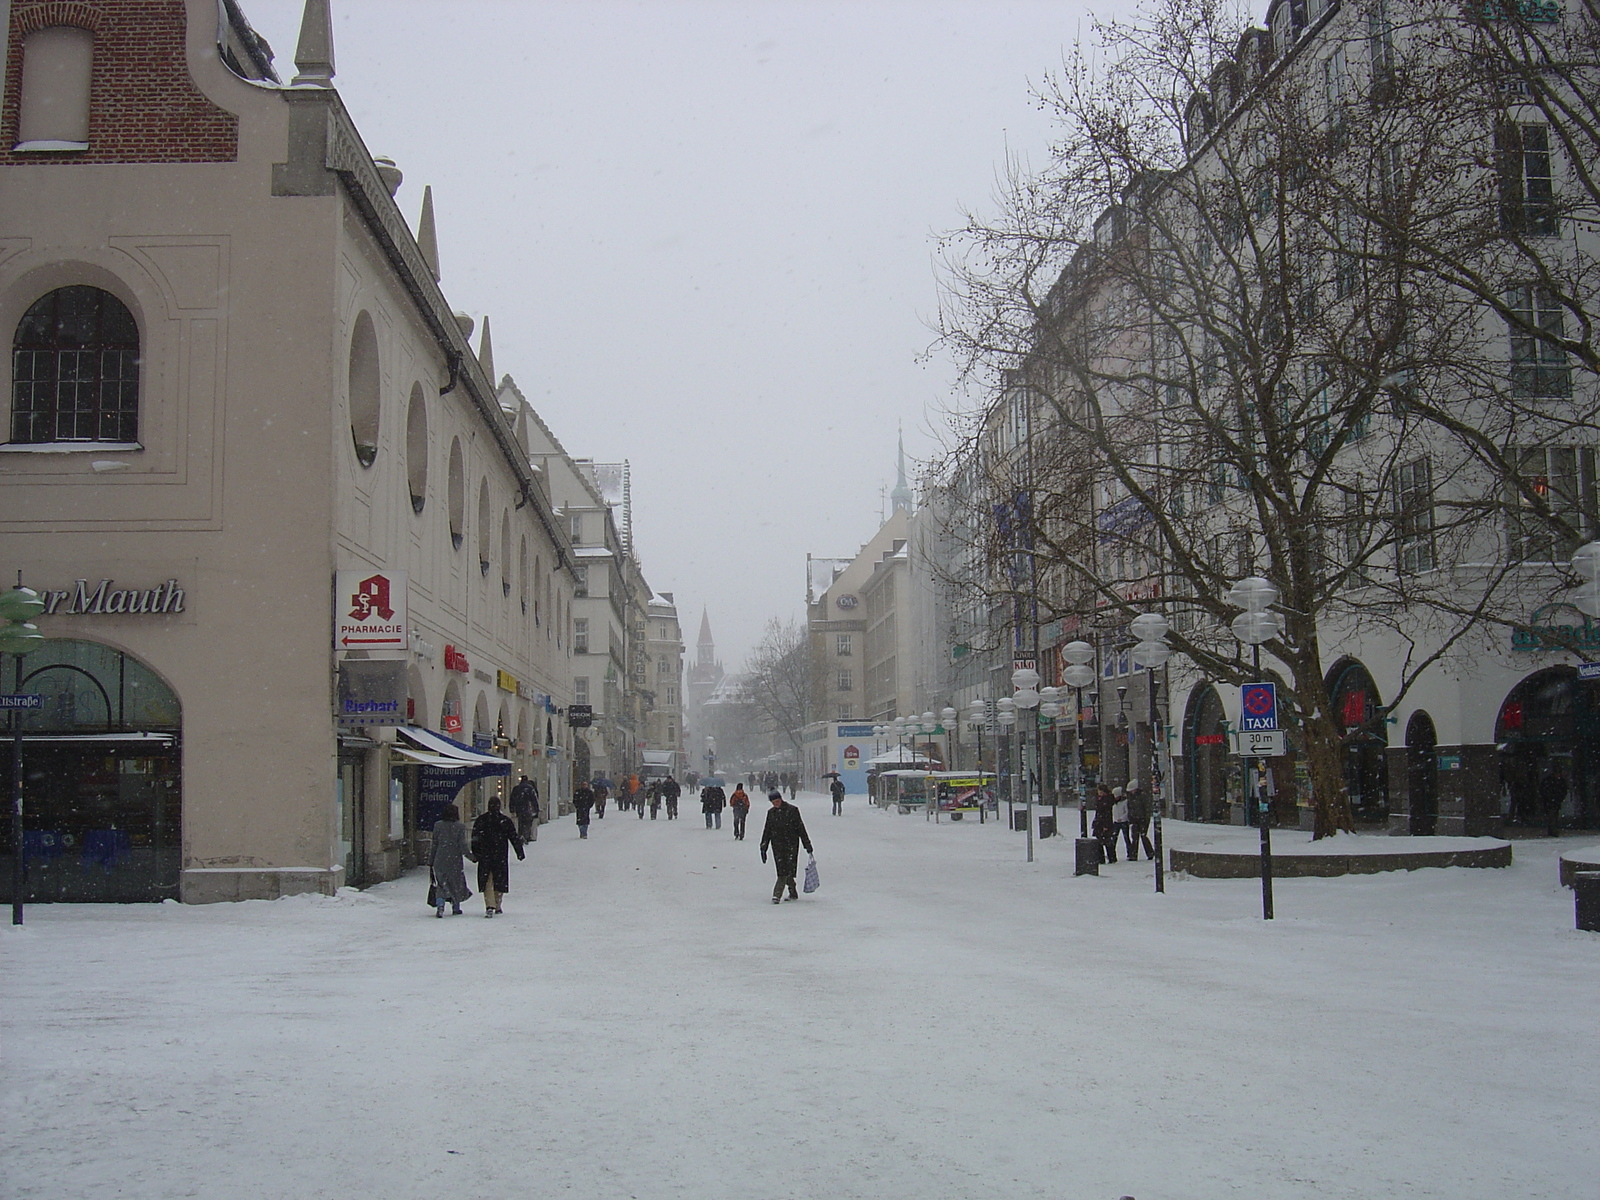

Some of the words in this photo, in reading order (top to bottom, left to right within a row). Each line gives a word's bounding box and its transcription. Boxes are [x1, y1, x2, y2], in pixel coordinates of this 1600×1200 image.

[66, 578, 185, 615] Mauth
[341, 625, 402, 633] PHARMACIE
[345, 700, 398, 712] Rischart
[1246, 718, 1273, 729] TAXI
[1250, 734, 1261, 742] 30
[423, 766, 465, 775] Souvenirs
[422, 778, 457, 788] Zigarren
